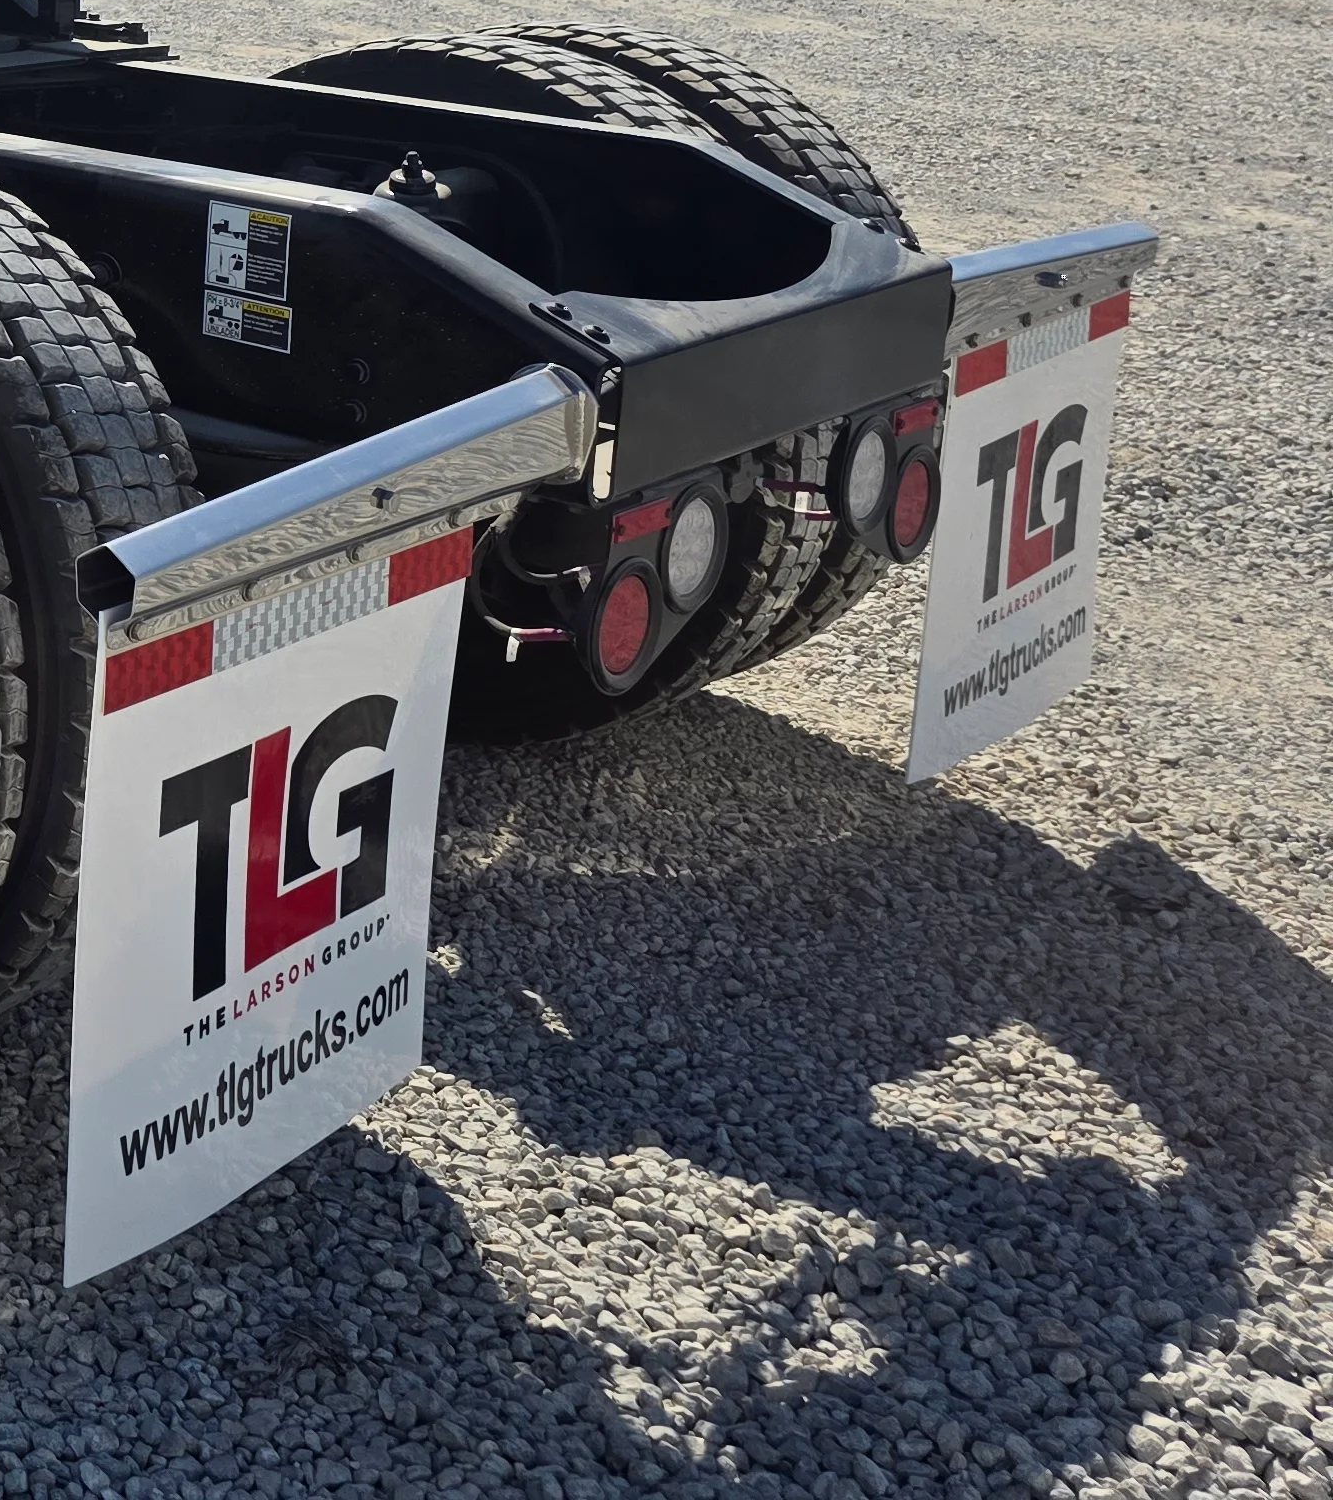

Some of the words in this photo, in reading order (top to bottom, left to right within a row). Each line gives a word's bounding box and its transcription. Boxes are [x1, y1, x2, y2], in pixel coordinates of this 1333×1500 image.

[257, 213, 289, 225] CAUTION
[207, 324, 240, 338] UNLADEN
[247, 303, 285, 317] ATTENTION
[977, 404, 1088, 603] TLG
[977, 610, 998, 634] THE
[999, 584, 1042, 621] LARSON
[1044, 565, 1074, 593] GROUP
[944, 606, 1086, 717] www.tlgtrucks.com
[159, 694, 398, 1002] TLG
[183, 1006, 226, 1046] THE
[233, 954, 315, 1020] LARSON
[321, 918, 385, 965] GROUP
[120, 968, 409, 1176] www.tlgtrucks.com
